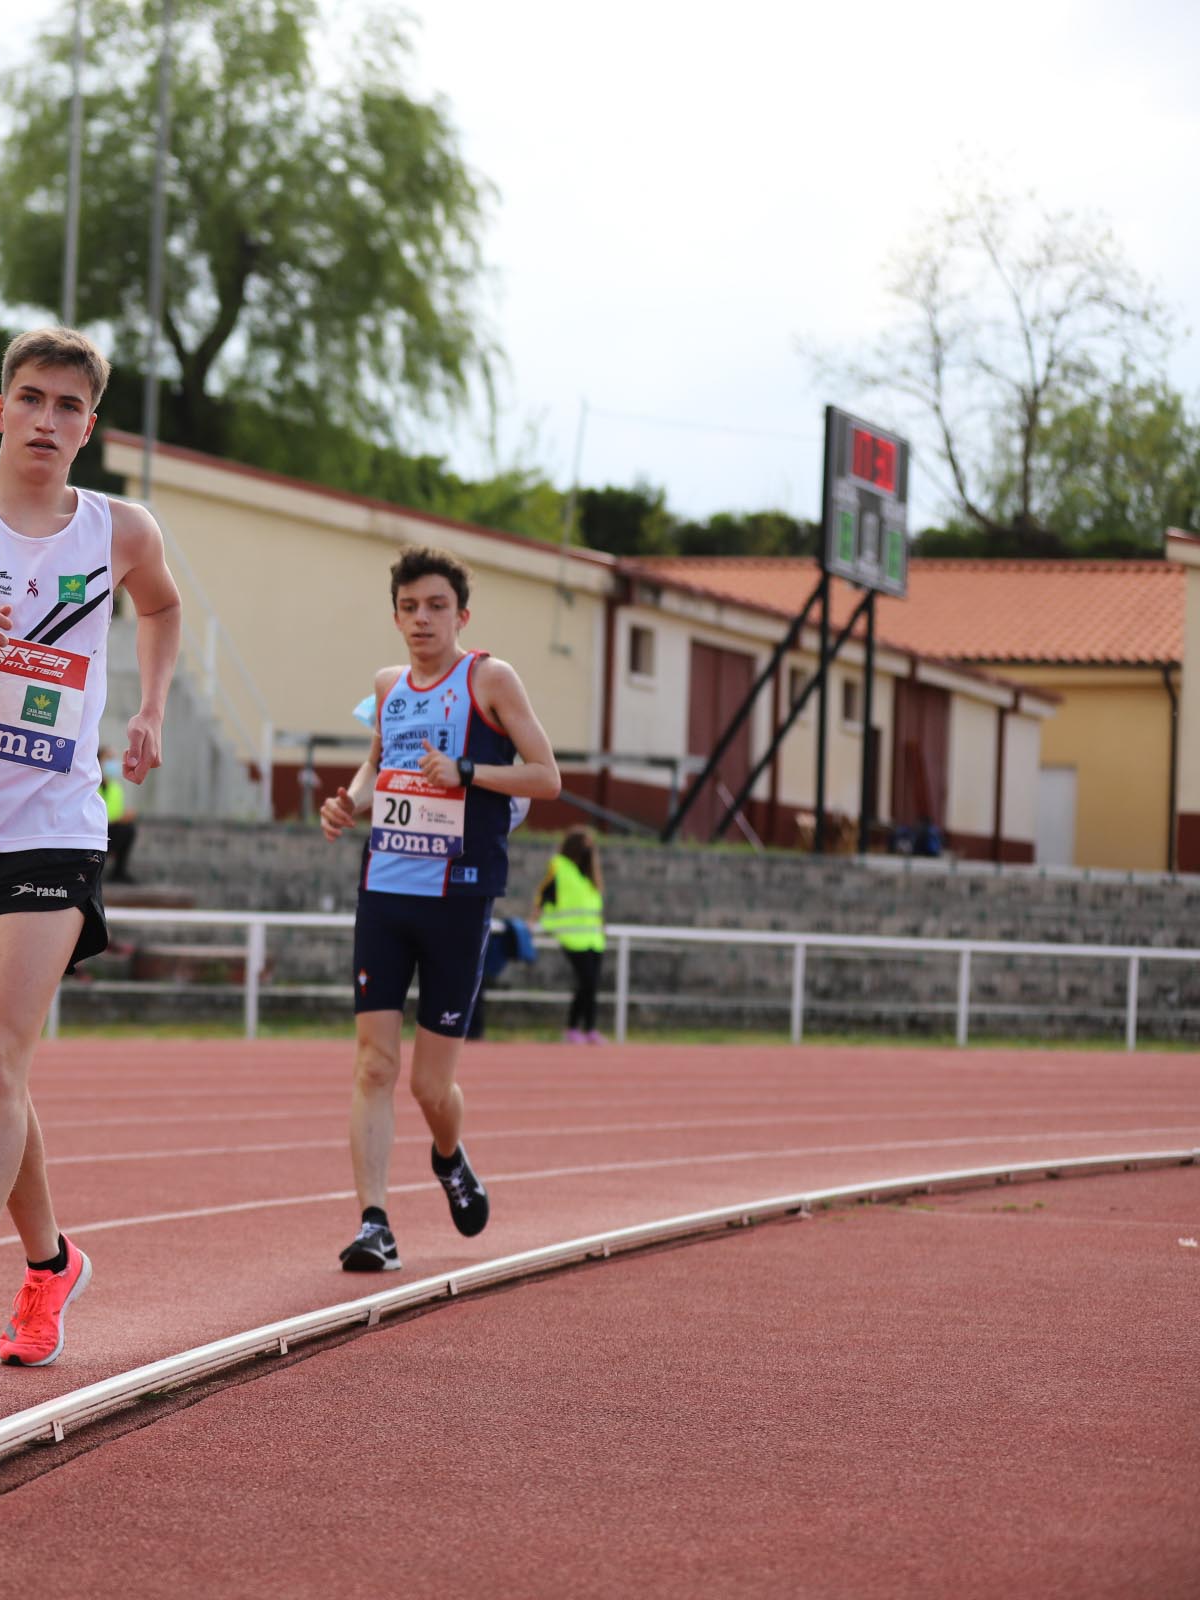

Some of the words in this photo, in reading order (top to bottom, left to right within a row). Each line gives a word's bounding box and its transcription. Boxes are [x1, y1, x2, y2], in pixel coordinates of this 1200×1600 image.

[4, 660, 64, 678] ATLETISMO
[10, 646, 71, 671] RFEA
[383, 797, 412, 826] 20
